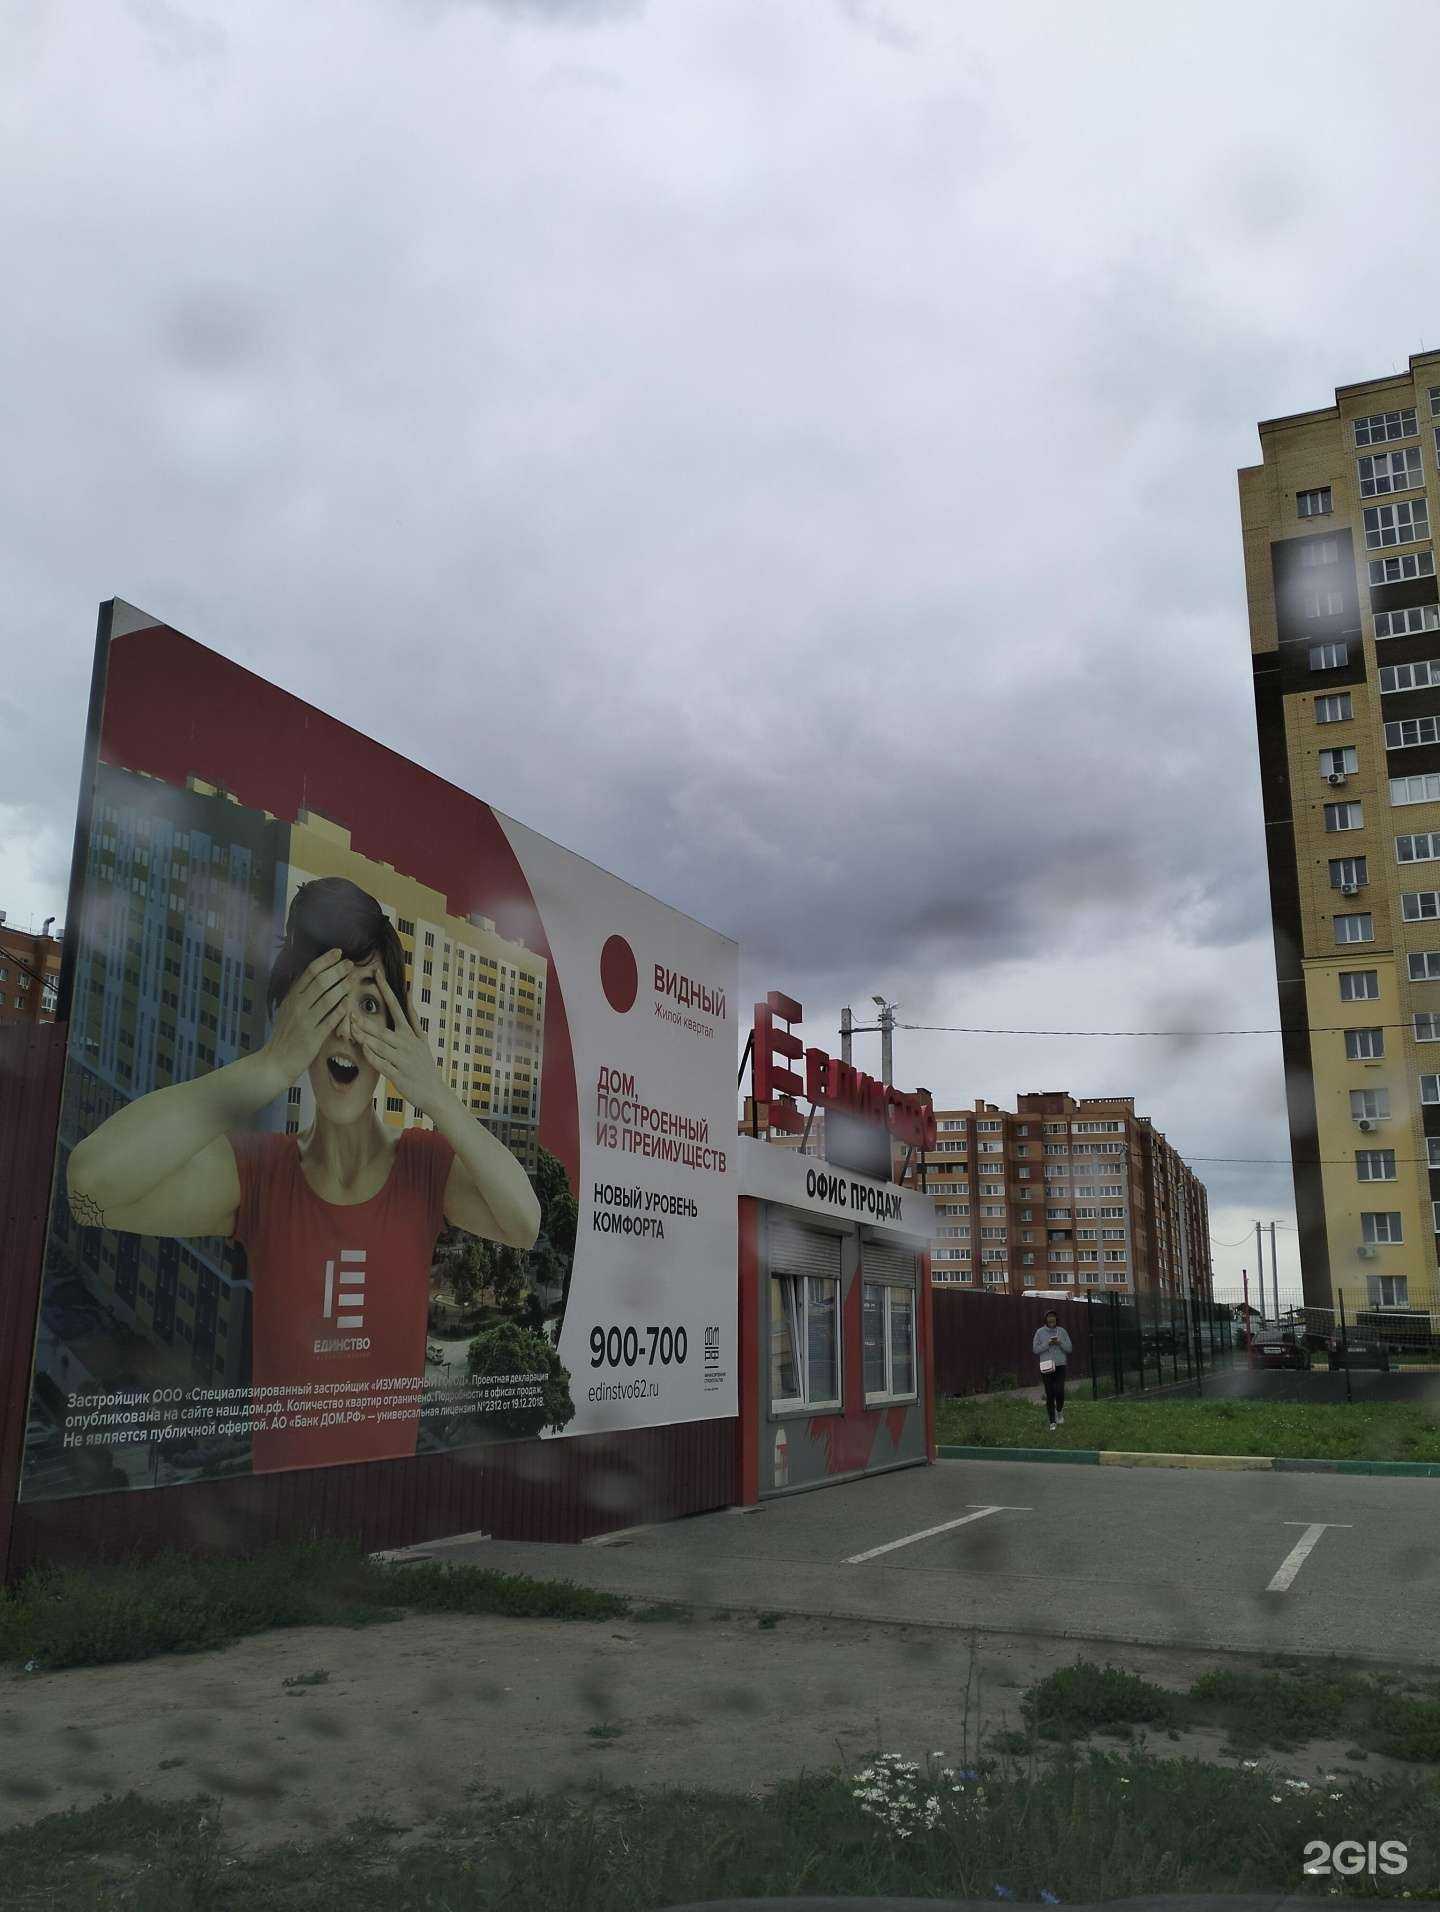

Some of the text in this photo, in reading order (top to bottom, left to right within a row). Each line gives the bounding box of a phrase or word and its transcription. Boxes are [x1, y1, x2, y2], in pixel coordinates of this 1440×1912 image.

[654, 963, 726, 1019] ВИДНЫЙ
[655, 1002, 714, 1038] Жилой квартал
[597, 1066, 638, 1102] ДОМ,
[597, 1094, 709, 1144] ПОСТРОЕННЫЙ
[596, 1122, 726, 1172] ИЗ ПРЕИМУЩЕСТВ
[594, 1183, 698, 1217] НОВЫЙ УРОВЕНЬ
[807, 1169, 902, 1221] ОФИС ПРОДАЖ
[593, 1211, 665, 1239] КОМФОРТА
[314, 1338, 371, 1353] ЕДИНСТВО
[590, 1326, 688, 1368] 900-700
[65, 1410, 161, 1430] опубликована
[164, 1410, 178, 1420] на
[181, 1406, 213, 1420] сайте
[216, 1401, 284, 1417] наш.дом.рф.
[287, 1397, 343, 1412] Количество
[345, 1395, 382, 1411] квартир
[490, 1387, 516, 1398] офисах
[67, 1391, 150, 1409] Застройщик
[152, 1388, 182, 1401] ООО
[185, 1383, 312, 1402] «Специализированный
[314, 1380, 369, 1397] застройщик
[472, 1374, 510, 1387] Проектная
[588, 1379, 659, 1401] edinstvo62.ru
[64, 1433, 82, 1447] Не
[86, 1430, 147, 1445] является
[150, 1422, 215, 1442] публичной
[218, 1419, 269, 1436] офертой.
[271, 1416, 287, 1429] АО
[290, 1414, 319, 1427] «Банк
[320, 1411, 365, 1427] ДОМ.РФ»
[377, 1406, 440, 1423] универсальная
[503, 1401, 510, 1410] от
